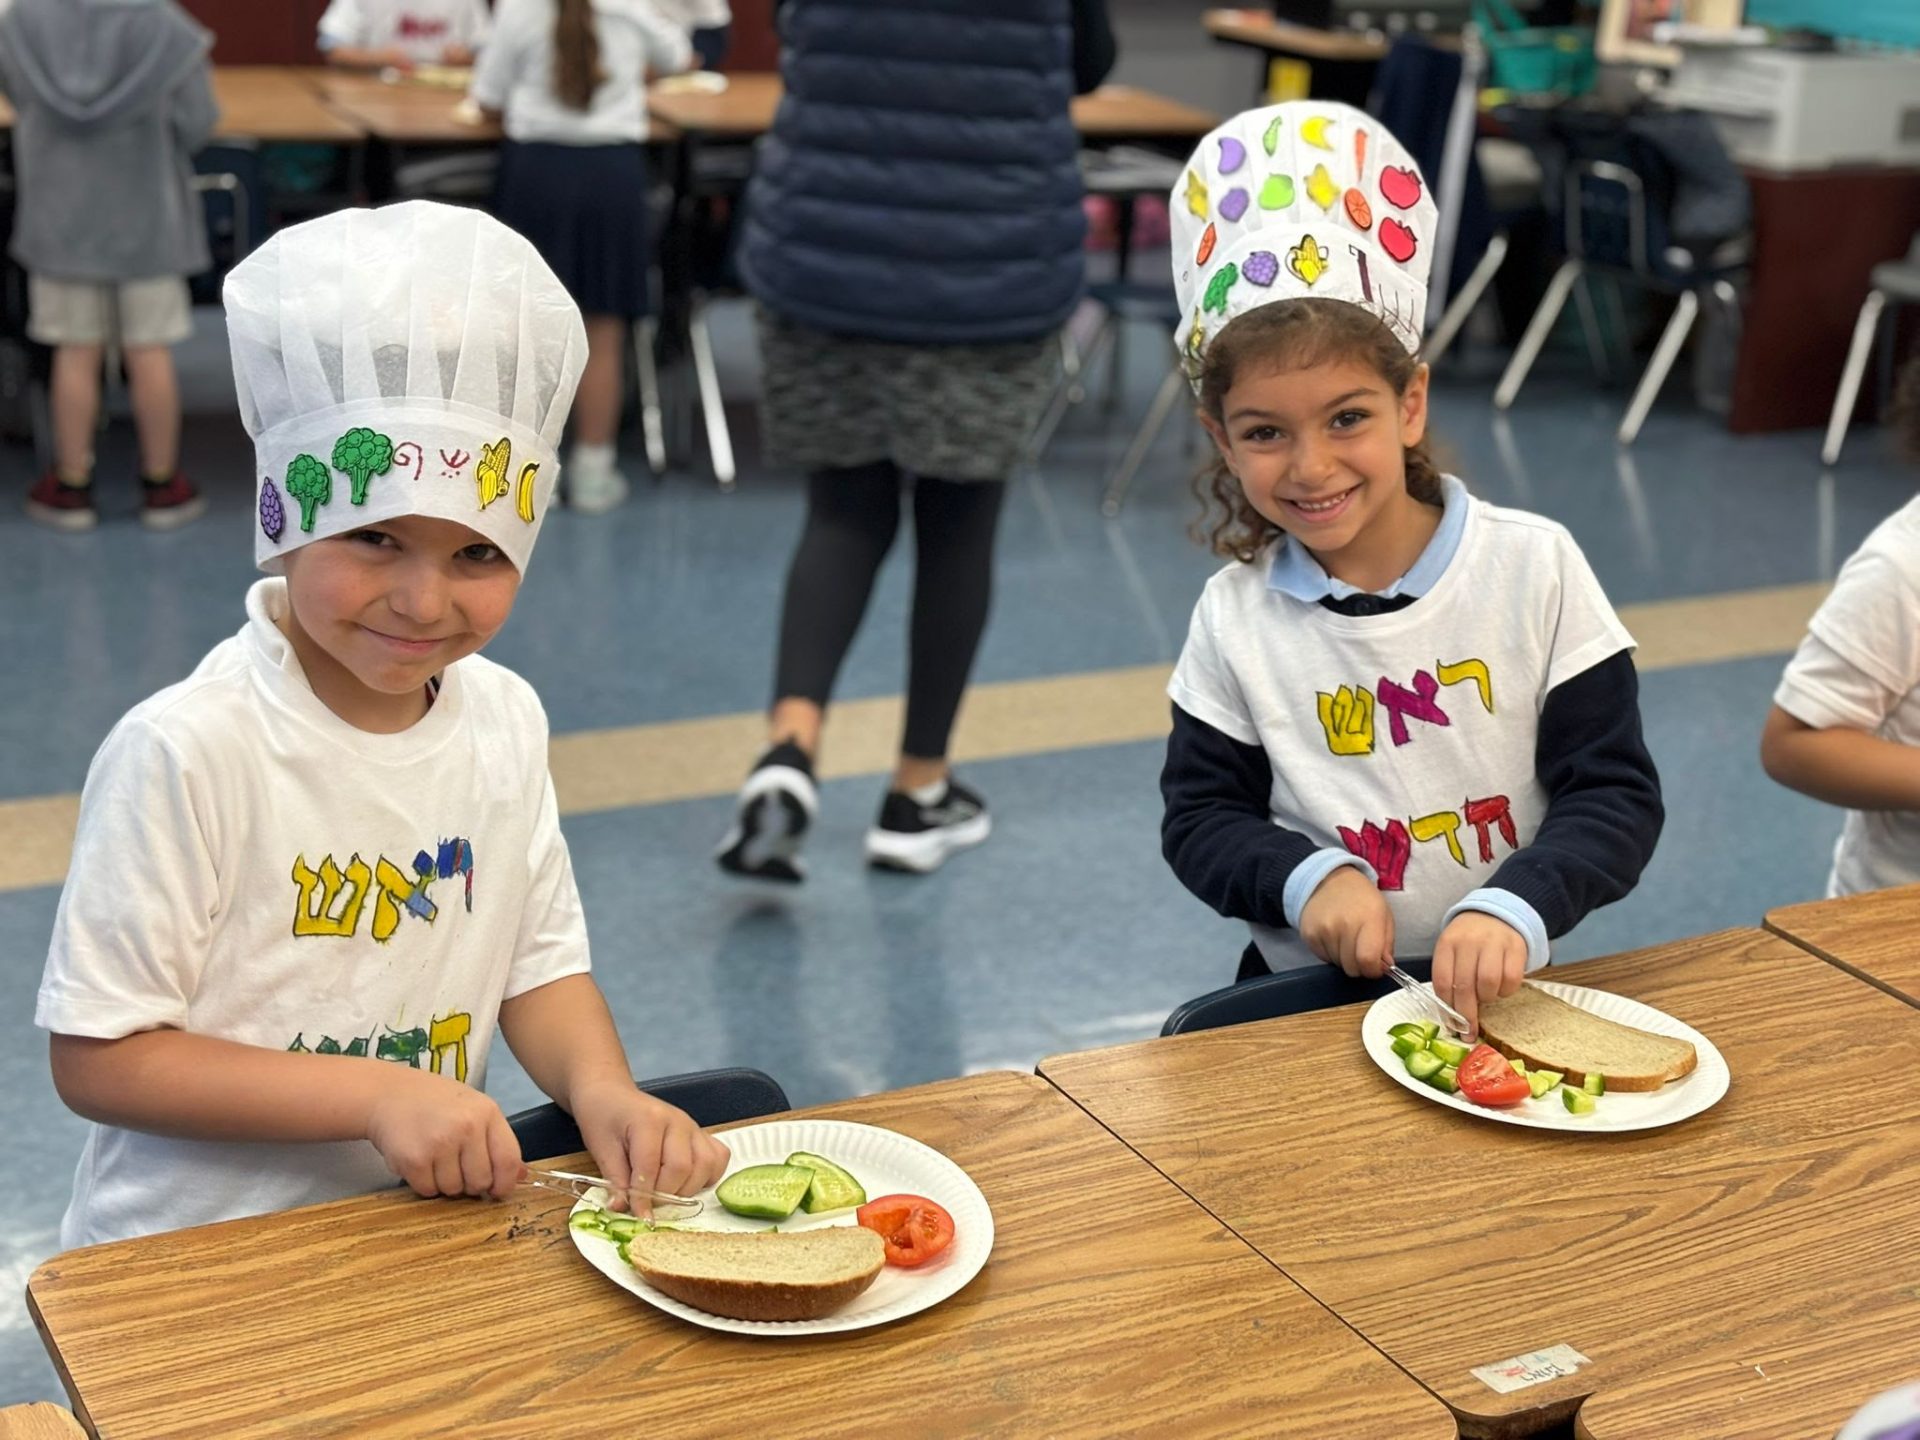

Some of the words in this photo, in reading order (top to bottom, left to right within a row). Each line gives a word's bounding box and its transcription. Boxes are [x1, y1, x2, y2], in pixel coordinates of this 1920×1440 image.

[1315, 658, 1494, 757] ראש
[291, 835, 474, 944] ראש
[1336, 794, 1519, 892] חדש
[287, 1011, 472, 1083] חד
